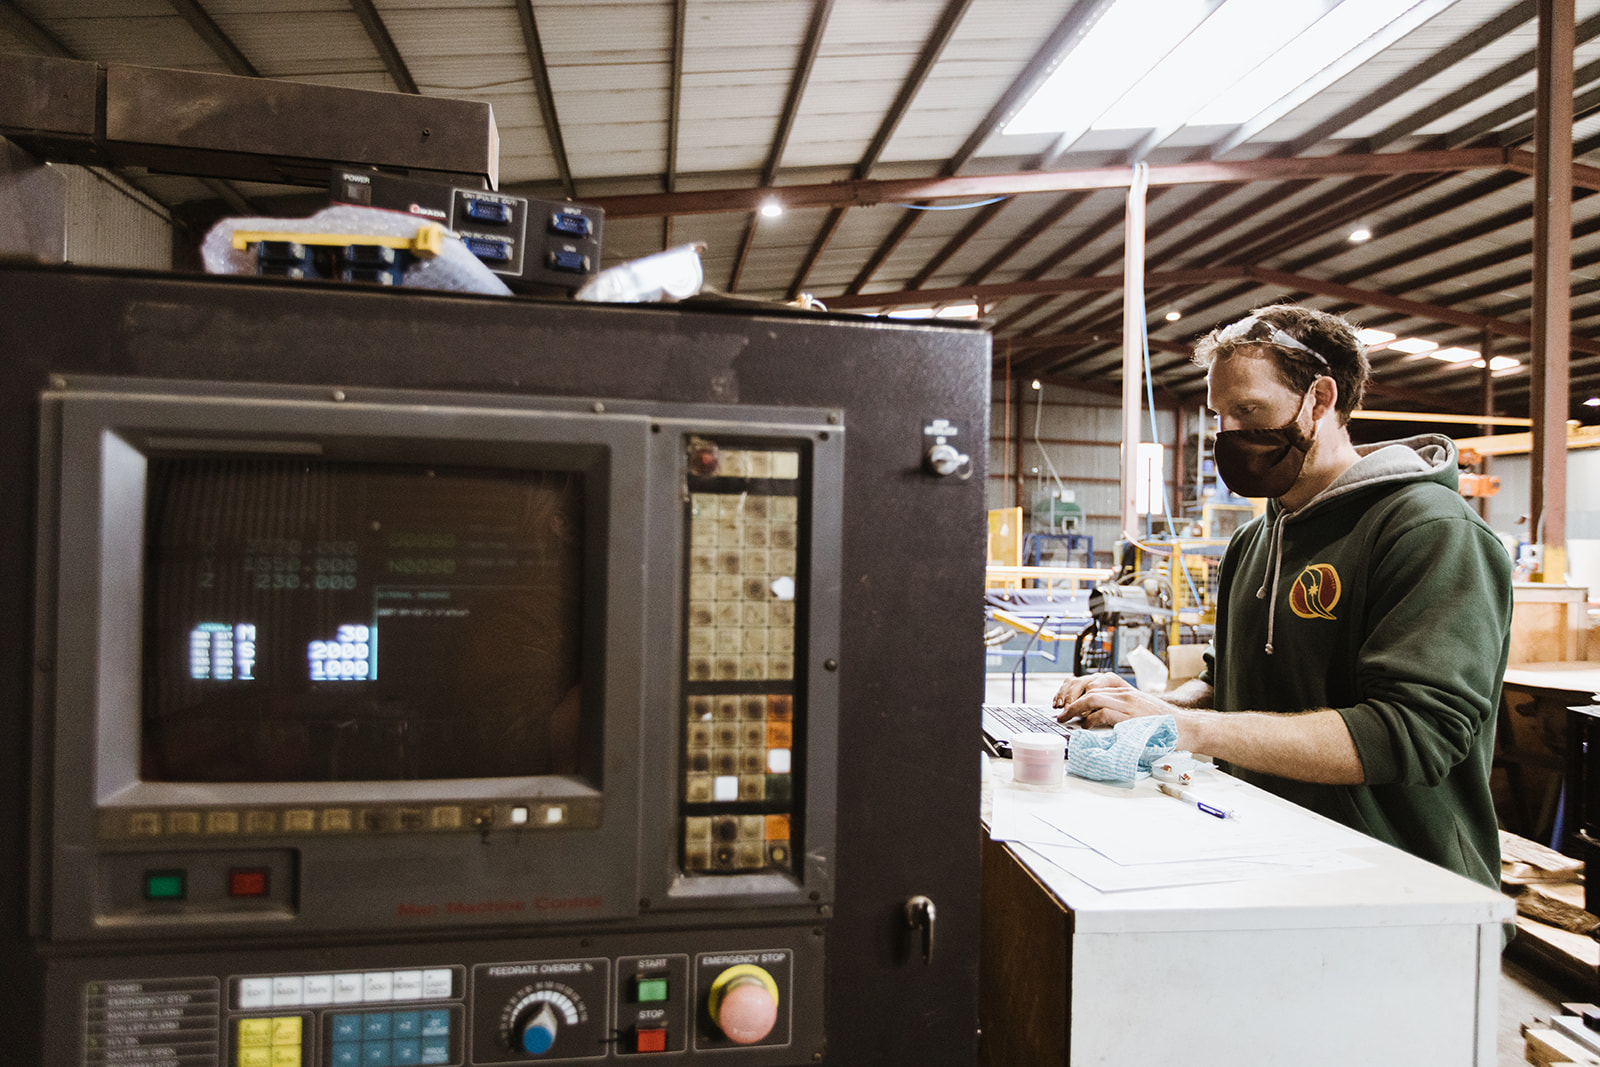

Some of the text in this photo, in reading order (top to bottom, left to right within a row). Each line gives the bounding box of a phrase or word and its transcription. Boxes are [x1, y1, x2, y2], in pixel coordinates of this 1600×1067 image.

[343, 173, 370, 184] POWER
[236, 624, 255, 641] M
[338, 624, 369, 641] 30
[237, 641, 369, 659] S 2000
[238, 660, 369, 677] T 1000
[638, 959, 668, 969] START
[702, 953, 786, 965] EMERGENCY STOP
[489, 965, 539, 975] FEEDRATE
[540, 963, 582, 973] OVERIDE
[639, 1010, 665, 1018] STOP
